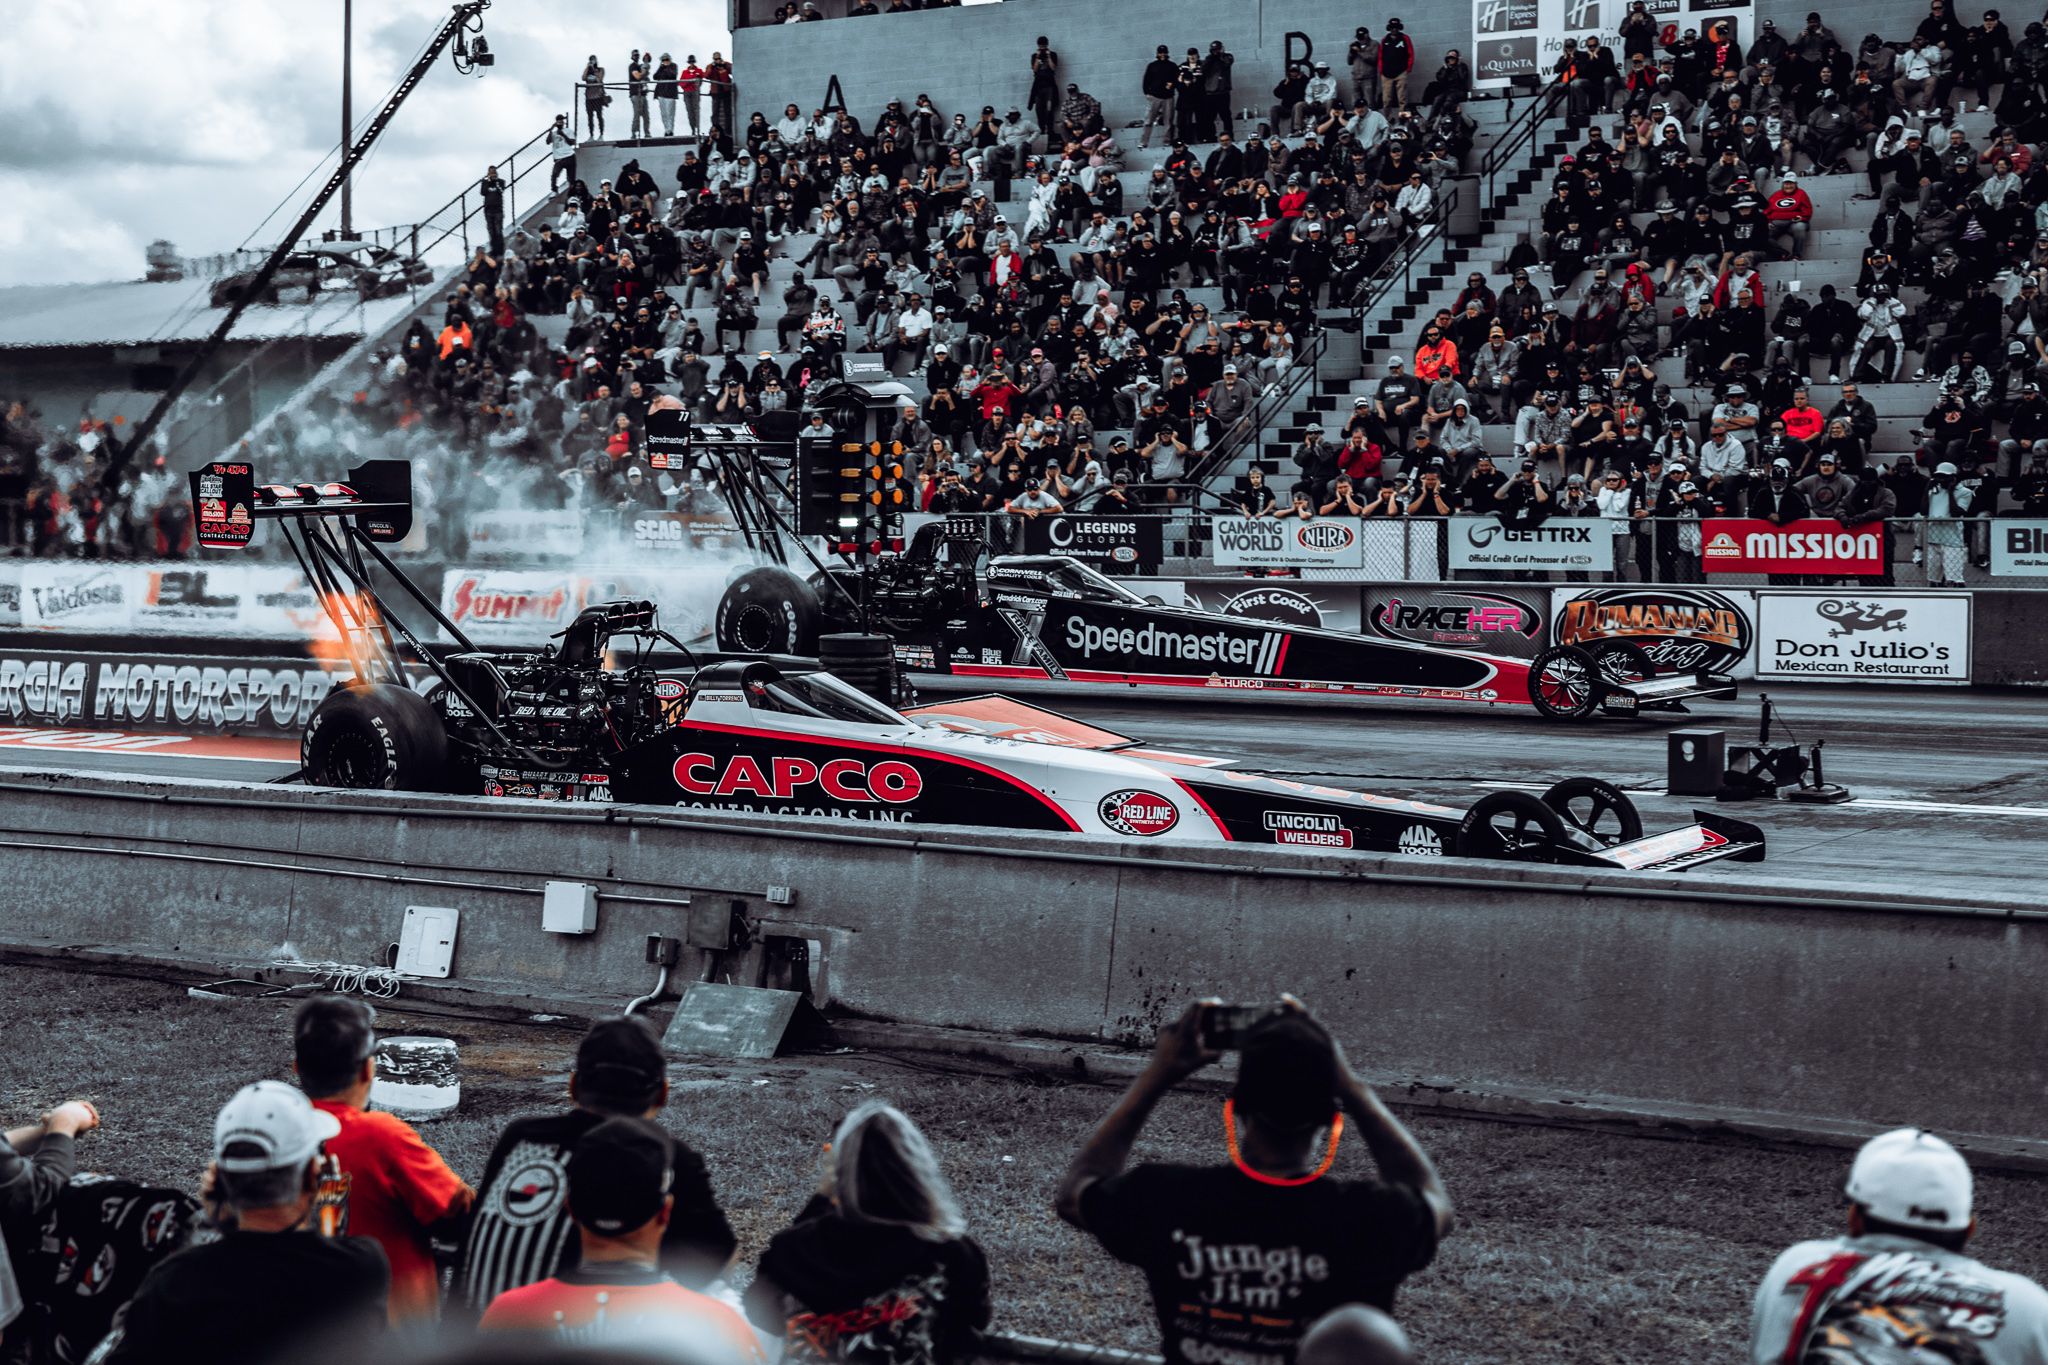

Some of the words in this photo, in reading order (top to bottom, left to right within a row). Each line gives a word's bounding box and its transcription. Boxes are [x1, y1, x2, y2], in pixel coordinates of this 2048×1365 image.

[1510, 11, 1537, 19] Express
[1284, 32, 1314, 77] B
[1488, 58, 1534, 72] QUINTA
[822, 74, 846, 113] A
[678, 411, 690, 422] 77
[648, 435, 684, 444] Speedmaster
[227, 465, 248, 475] 474
[199, 523, 250, 535] CAPCO
[635, 519, 682, 541] SCAG
[1076, 522, 1136, 534] LEGENDS
[1218, 521, 1283, 534] CAMPING
[1504, 527, 1592, 542] GETTRX
[1076, 535, 1136, 544] GLOBAL
[1219, 534, 1284, 551] WORLD
[1305, 527, 1345, 547] NHRA
[1745, 533, 1878, 560] MISSION
[1468, 554, 1491, 562] Official
[1492, 554, 1511, 563] Credit
[1513, 554, 1528, 563] Card
[1529, 555, 1559, 564] Processor
[1560, 555, 1568, 564] of
[997, 568, 1043, 576] CORNWELL
[1230, 593, 1266, 614] First
[1269, 593, 1312, 614] Coast
[1010, 613, 1035, 643] FORCE
[1561, 600, 1739, 645] ROMANIAC
[1066, 615, 1259, 665] Speedmaster
[982, 648, 1002, 656] Blue
[1775, 639, 1839, 657] Don
[1850, 640, 1950, 660] Julio's
[1033, 643, 1062, 676] FAMILY
[1775, 660, 1849, 672] Mexican
[1854, 661, 1950, 675] Restaurant
[654, 682, 682, 696] NHRA
[1224, 679, 1264, 689] HURCO
[446, 709, 474, 717] OOLS
[515, 706, 534, 715] RED
[552, 706, 568, 716] OIL
[371, 716, 397, 771] EAGLE
[672, 752, 923, 804] CAPCO
[589, 786, 614, 801] MAC
[1122, 804, 1144, 819] RED
[1146, 805, 1172, 820] LINE
[1268, 814, 1336, 832] LINCOLN
[1284, 832, 1344, 846] WELDERS
[1399, 824, 1442, 846] MAC
[1399, 846, 1443, 856] TOOLS
